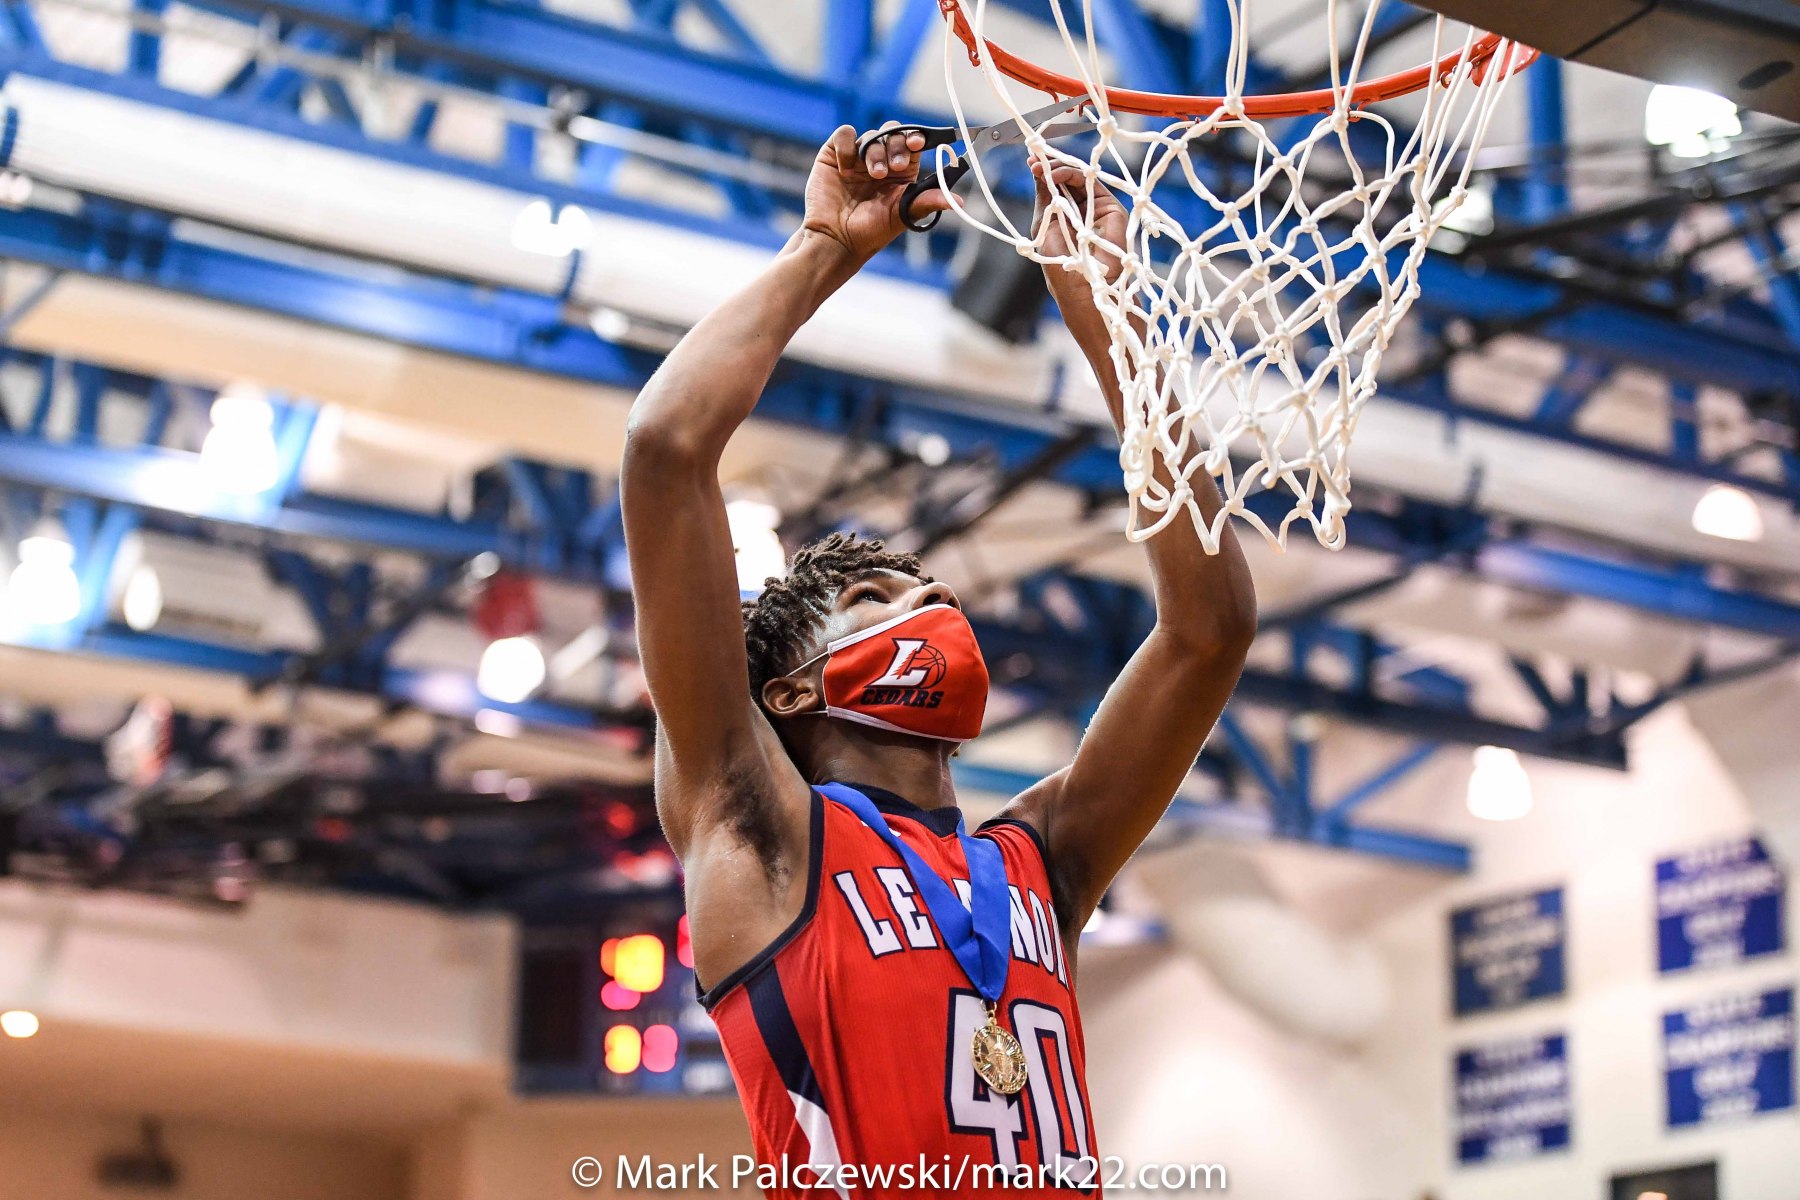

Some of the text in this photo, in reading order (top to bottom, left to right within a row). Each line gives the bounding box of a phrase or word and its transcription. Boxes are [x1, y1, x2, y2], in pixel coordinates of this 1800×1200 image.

[864, 637, 928, 688] L
[860, 688, 944, 709] CEDARS
[944, 987, 1095, 1195] 40
